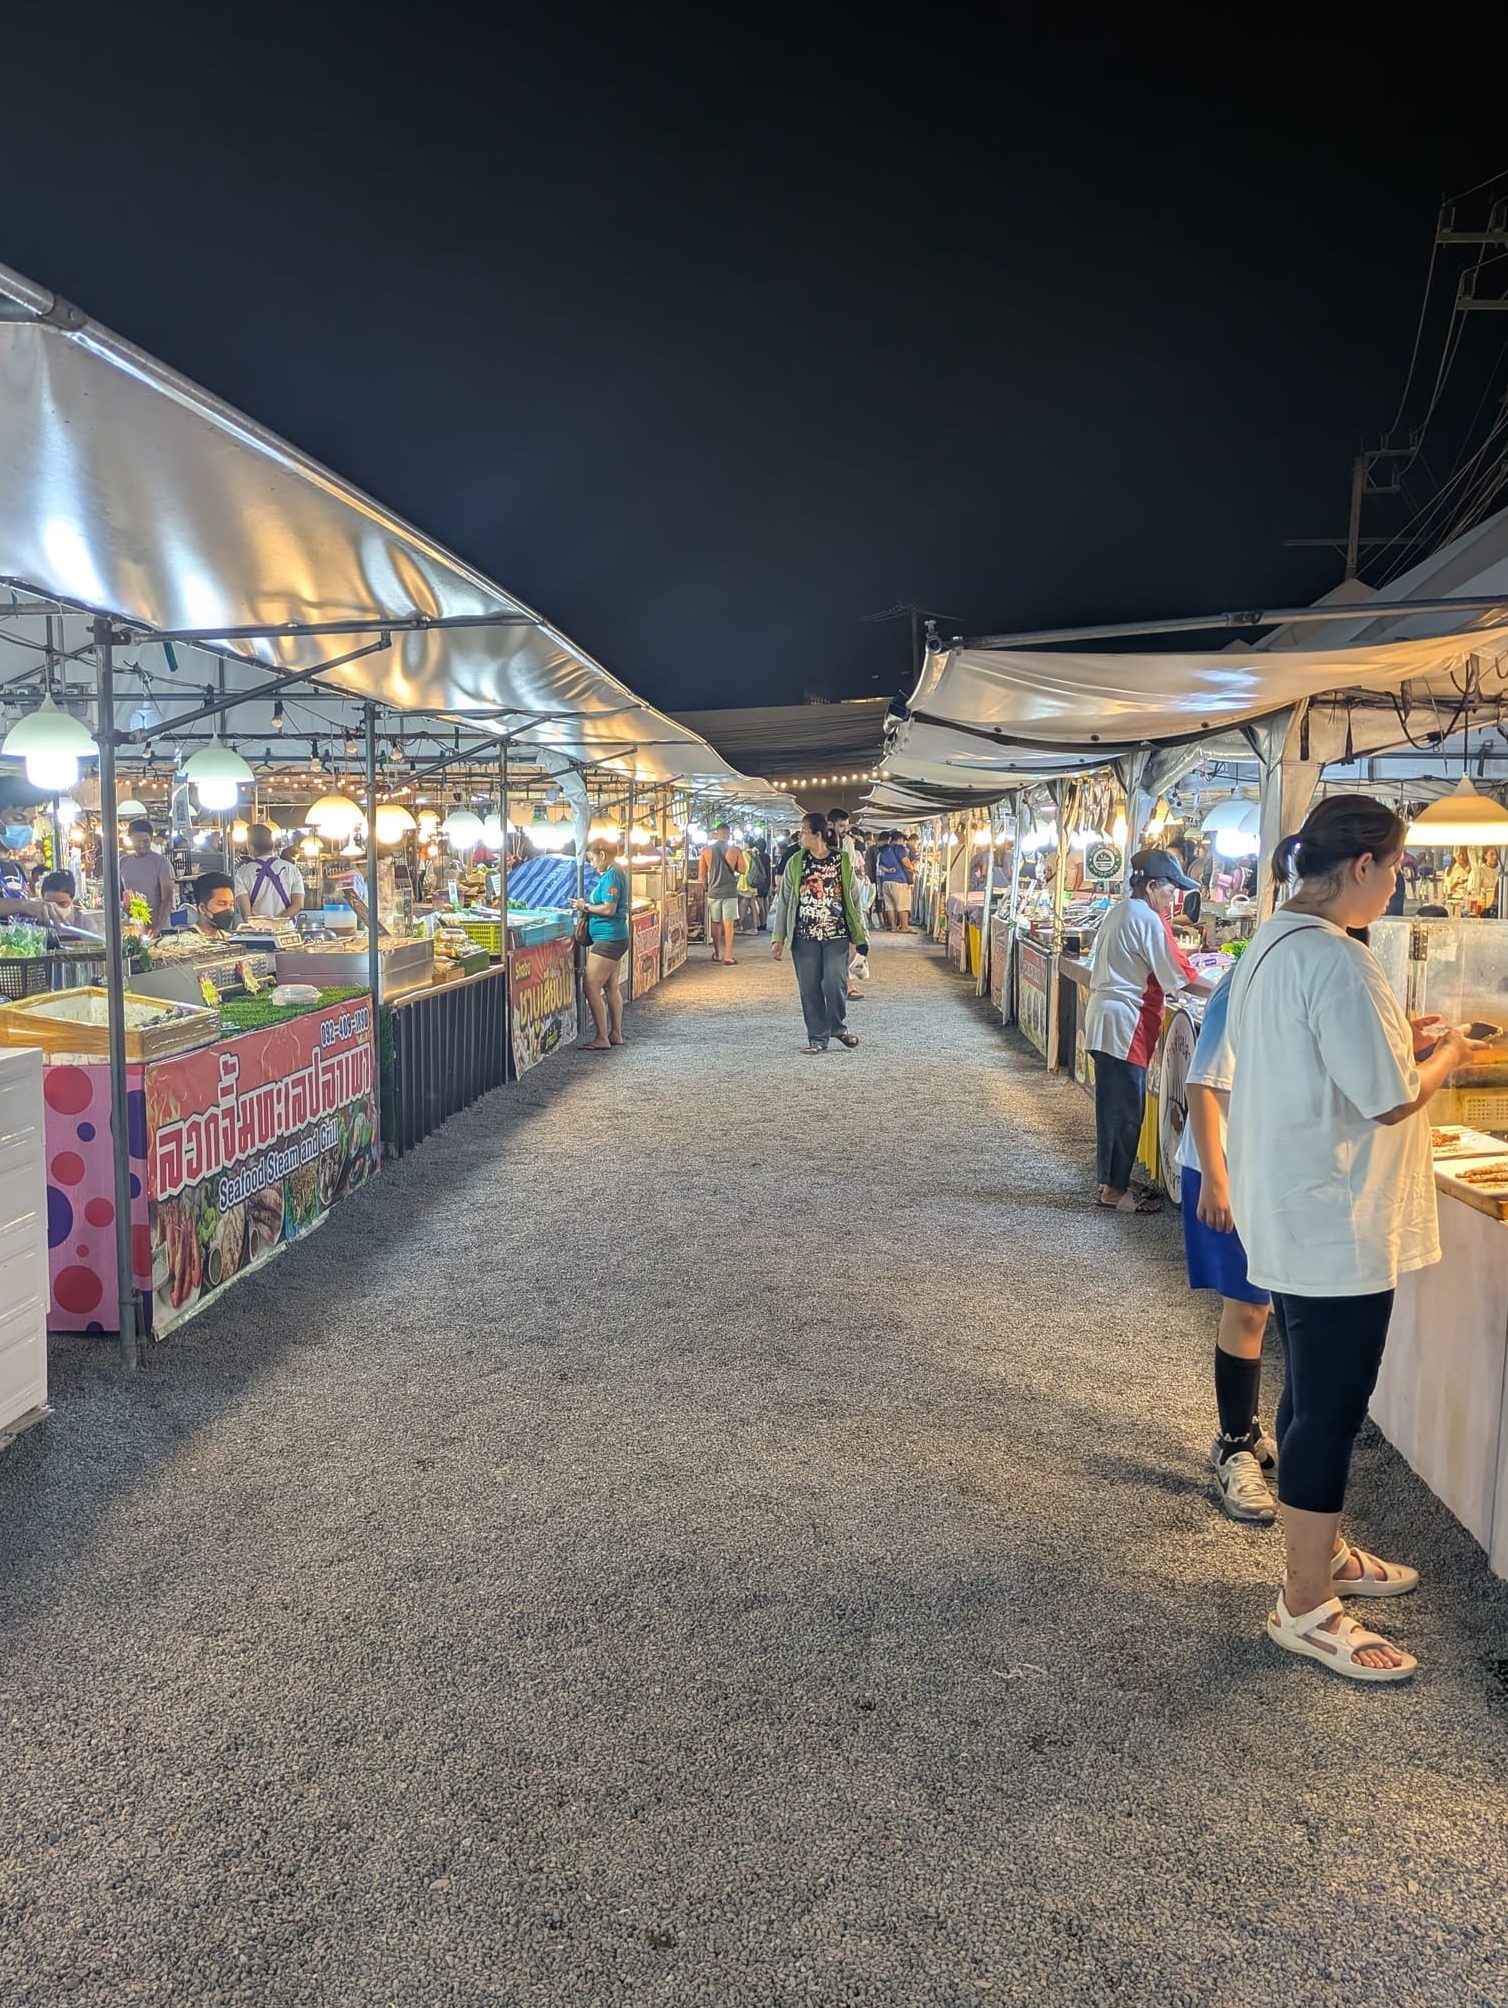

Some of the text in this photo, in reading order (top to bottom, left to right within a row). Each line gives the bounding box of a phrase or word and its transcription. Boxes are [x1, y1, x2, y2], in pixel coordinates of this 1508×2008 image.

[156, 1043, 371, 1202] ลวกจิ้มทะเลปลาเผา
[219, 1117, 338, 1211] Seafood Steam and Grill
